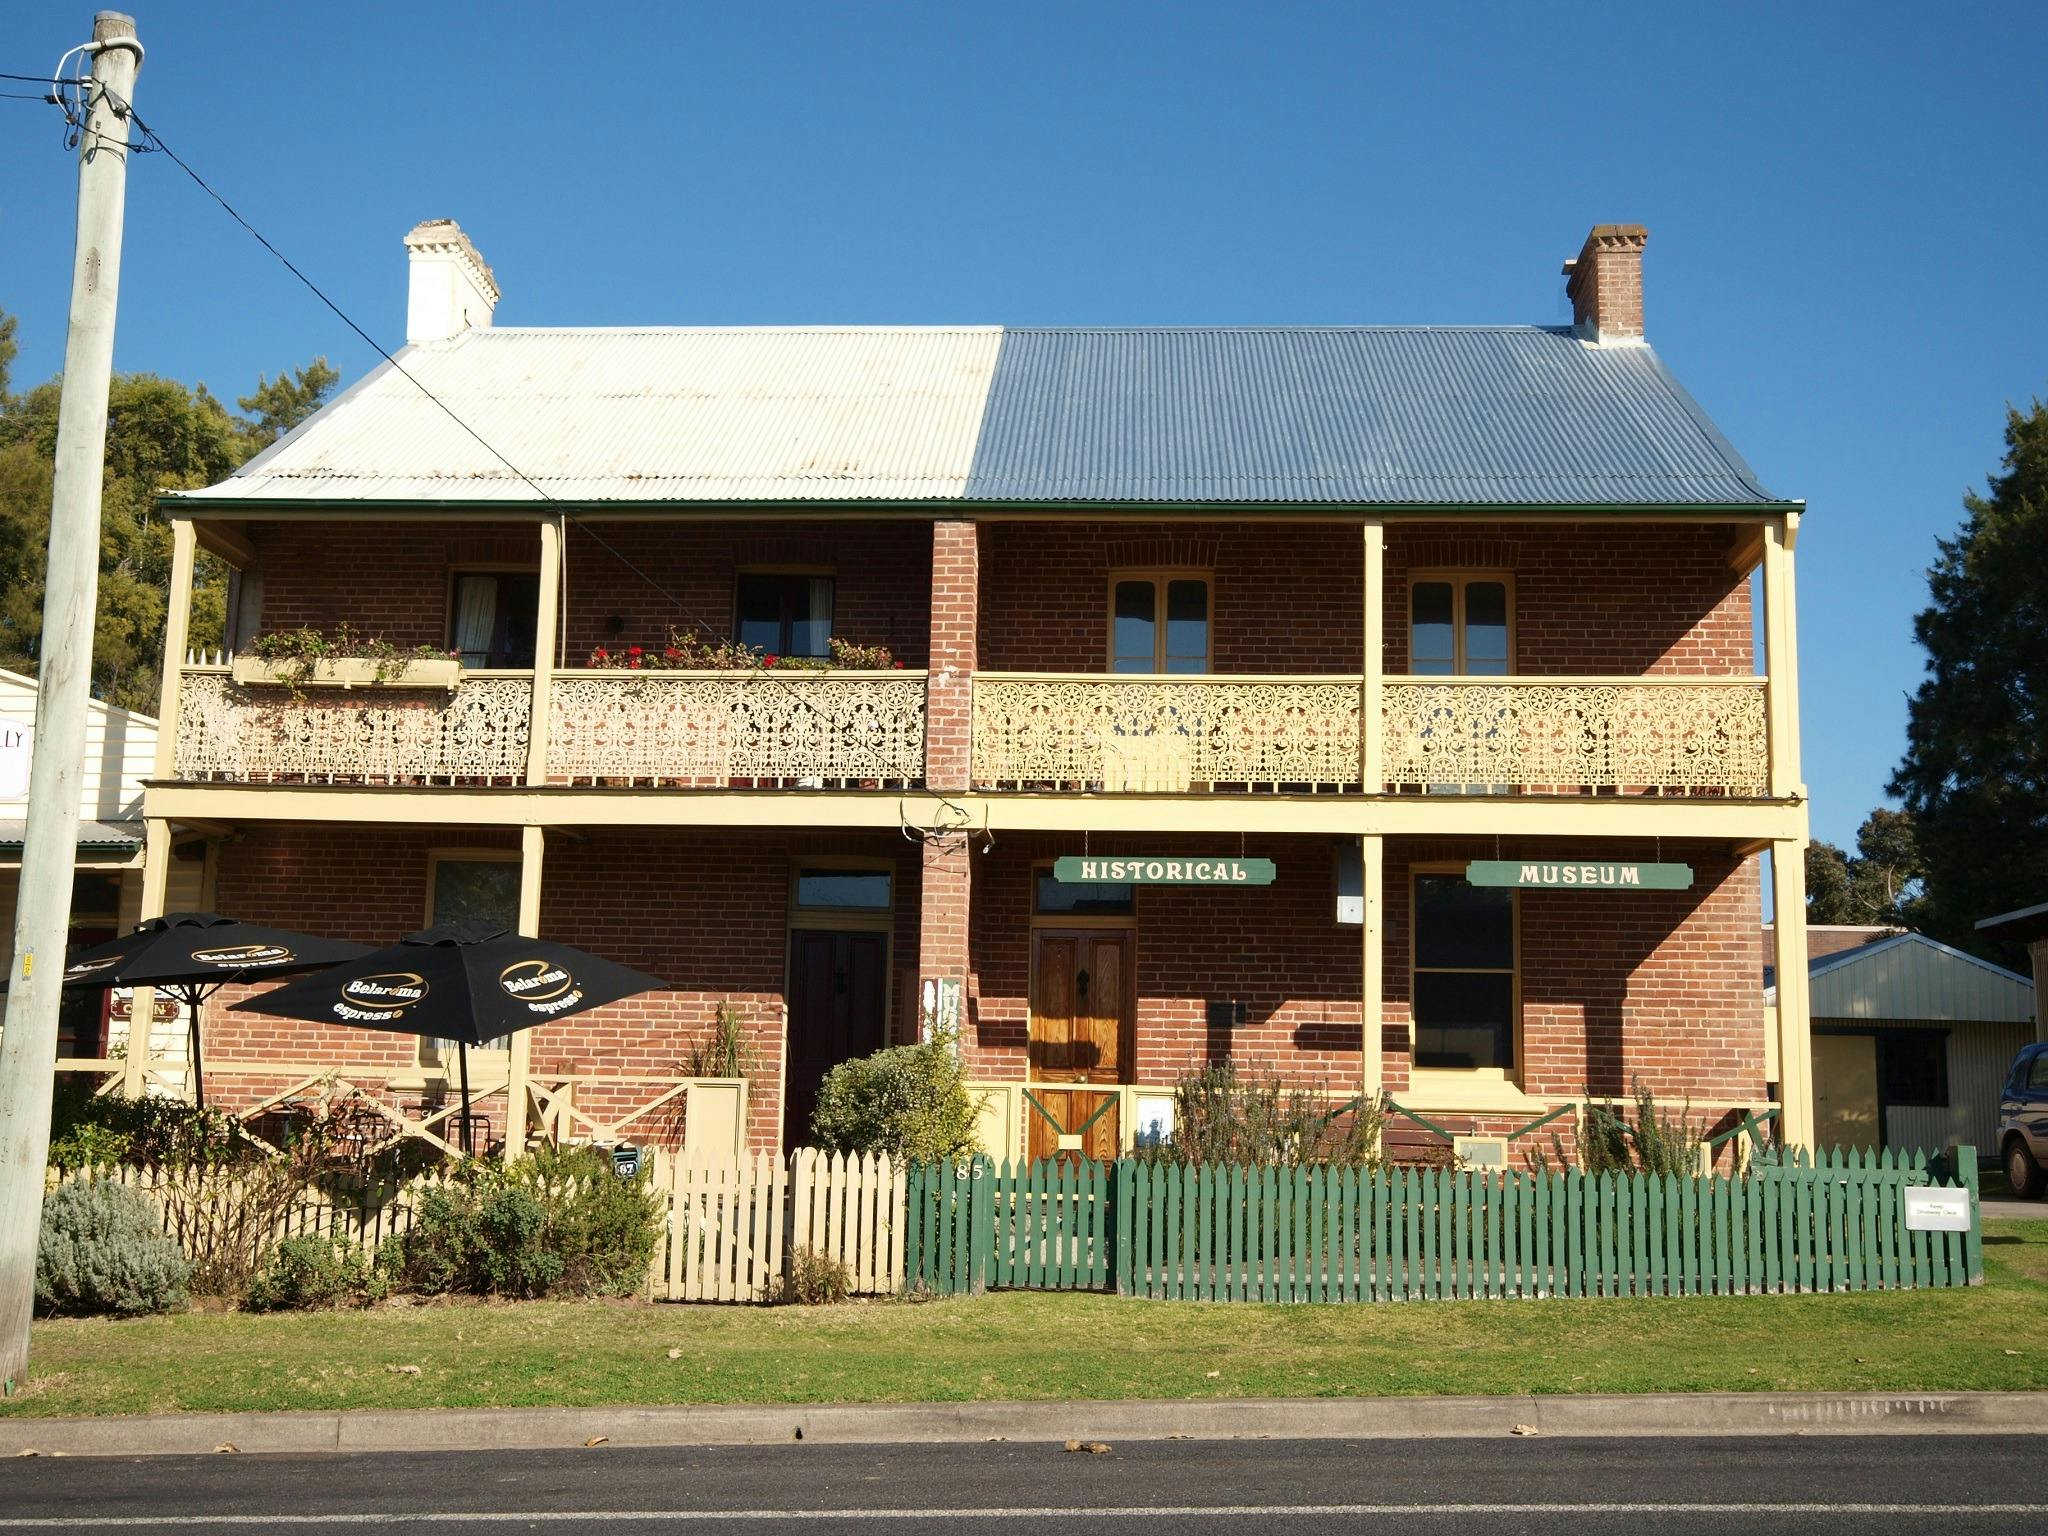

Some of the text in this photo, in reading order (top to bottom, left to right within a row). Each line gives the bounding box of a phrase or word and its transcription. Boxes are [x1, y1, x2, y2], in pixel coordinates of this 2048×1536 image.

[1081, 861, 1247, 880] HISTORICAL
[1518, 865, 1640, 885] MUSEUM
[346, 980, 422, 999] Belaroma
[503, 970, 568, 993] Belaroma
[527, 989, 583, 1015] espresso
[332, 1003, 404, 1021] espresso
[956, 1164, 983, 1180] 85
